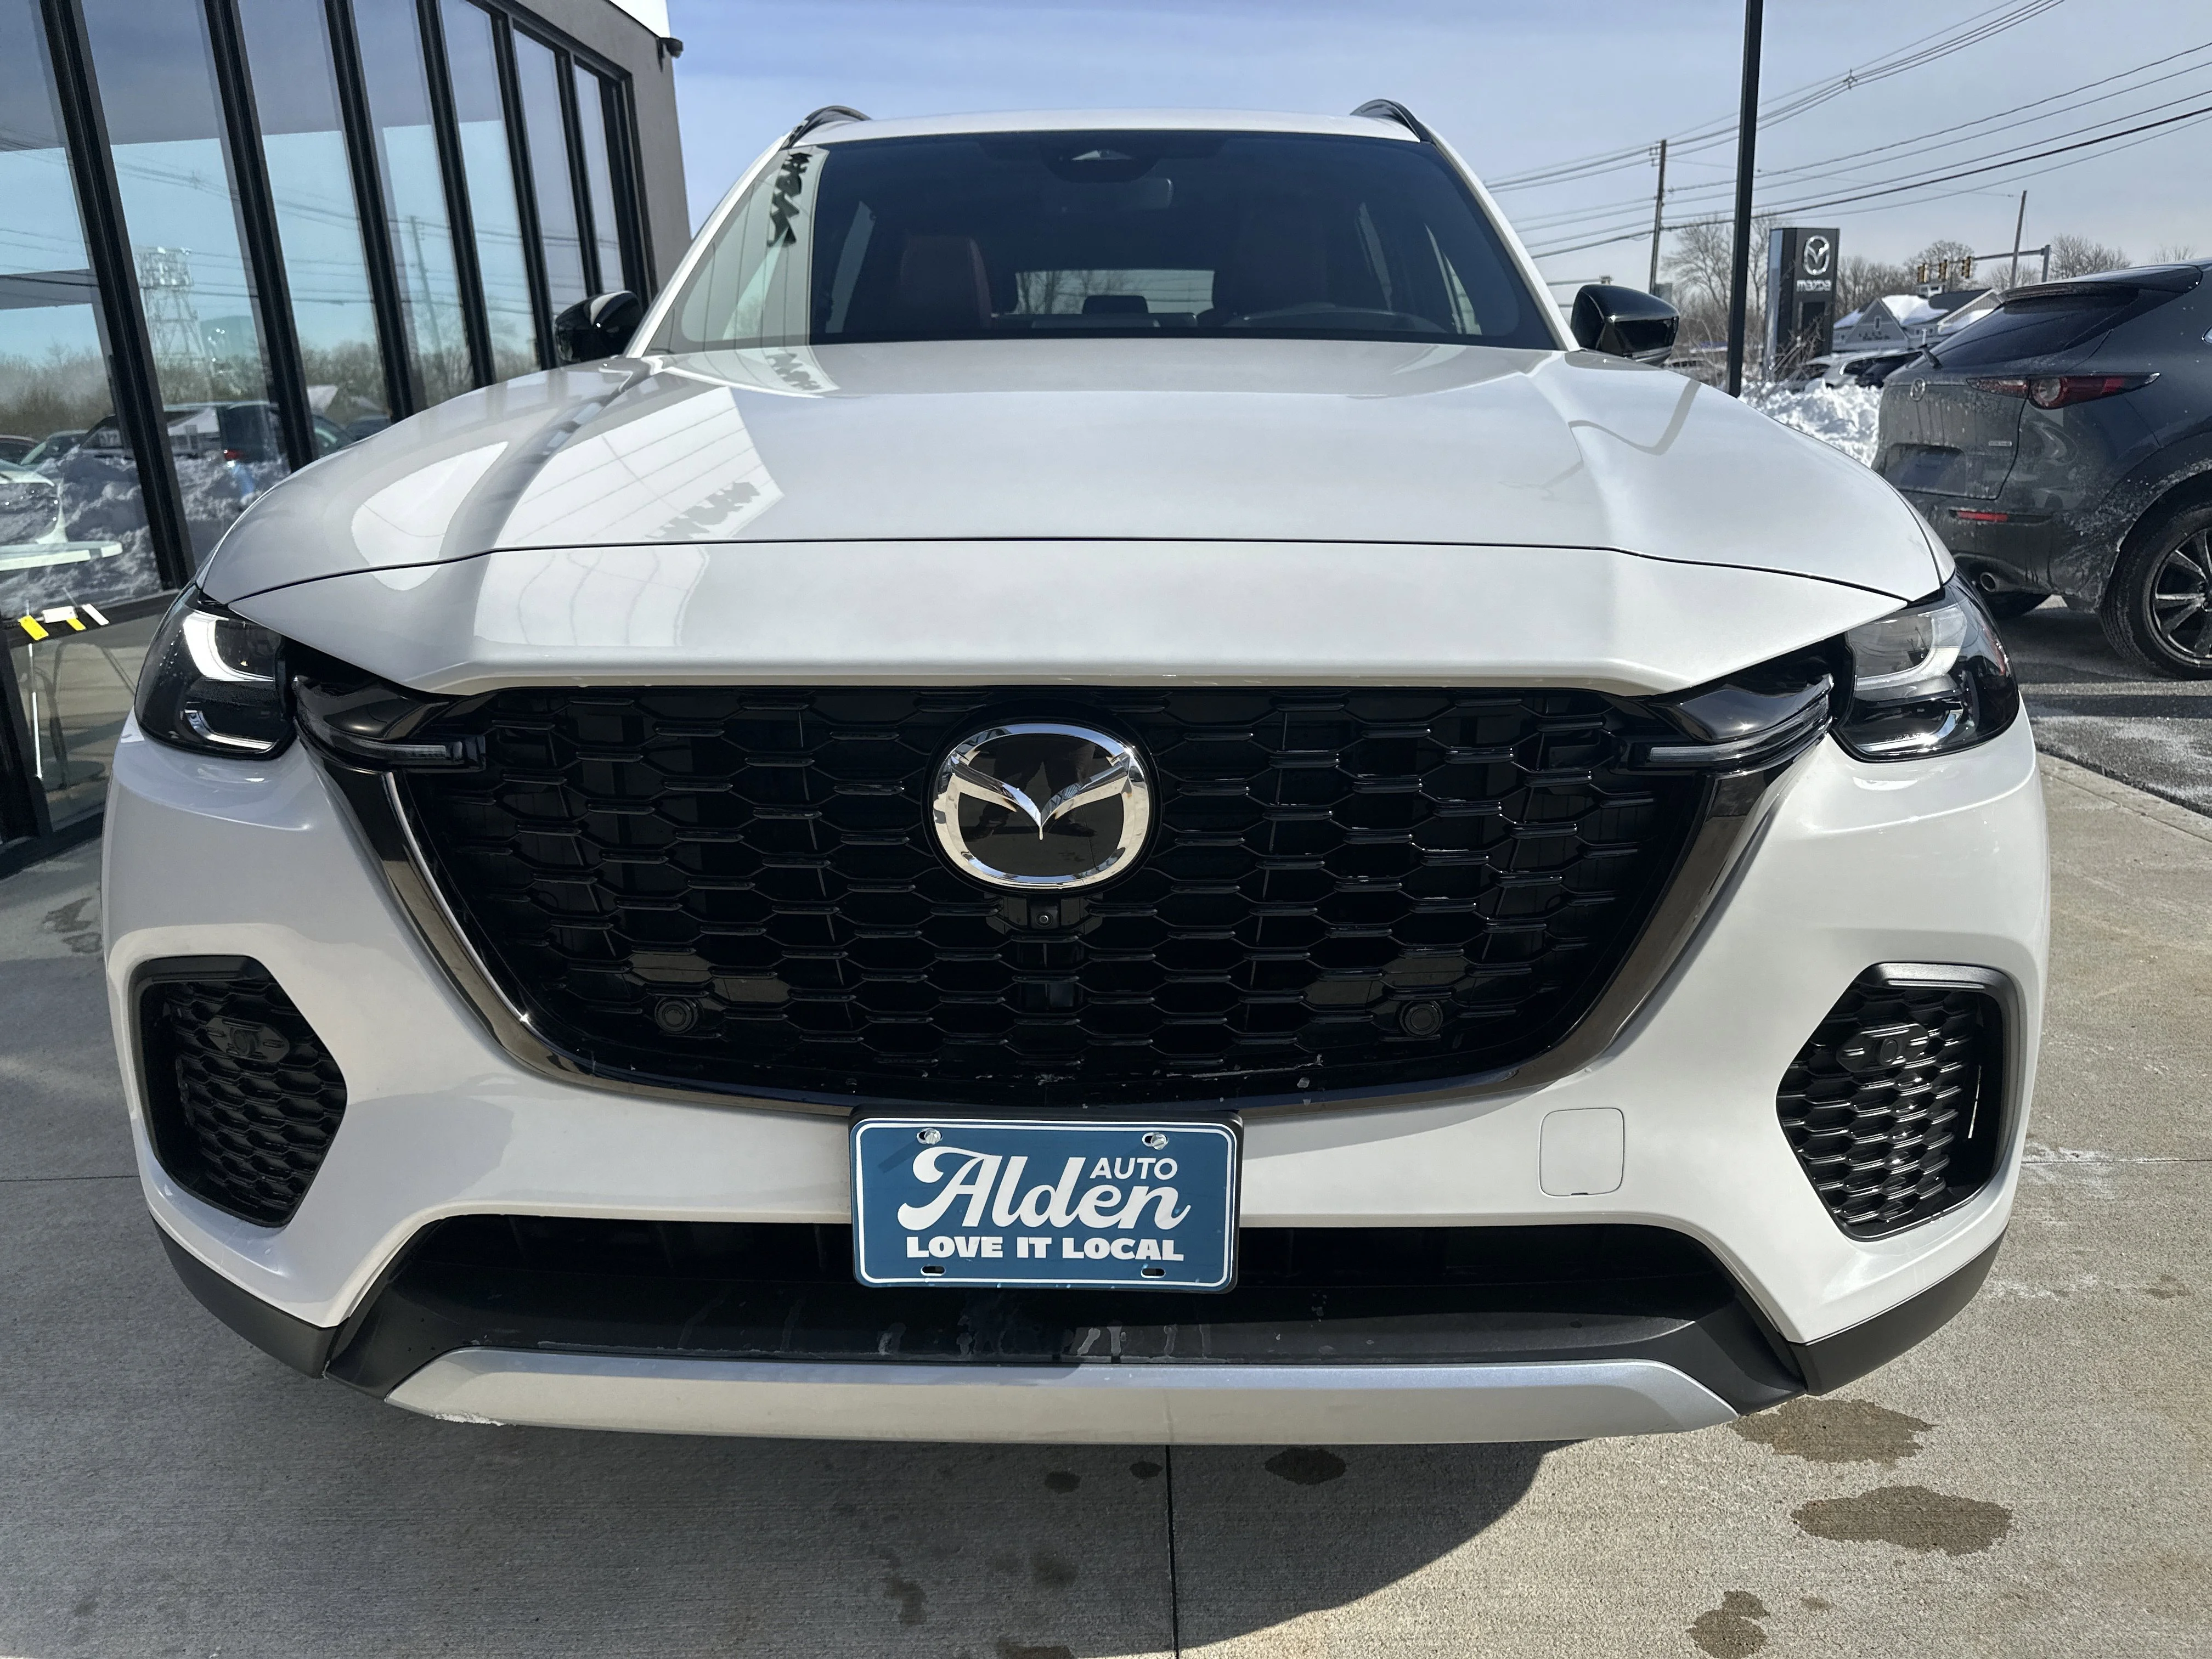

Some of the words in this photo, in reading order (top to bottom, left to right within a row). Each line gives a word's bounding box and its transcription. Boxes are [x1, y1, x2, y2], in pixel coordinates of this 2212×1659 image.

[1090, 1158, 1177, 1180] AUTO
[898, 1147, 1190, 1230] Alden
[907, 1236, 1003, 1257] LOVE
[1017, 1237, 1052, 1258] IT
[1063, 1238, 1184, 1261] LOCAL
